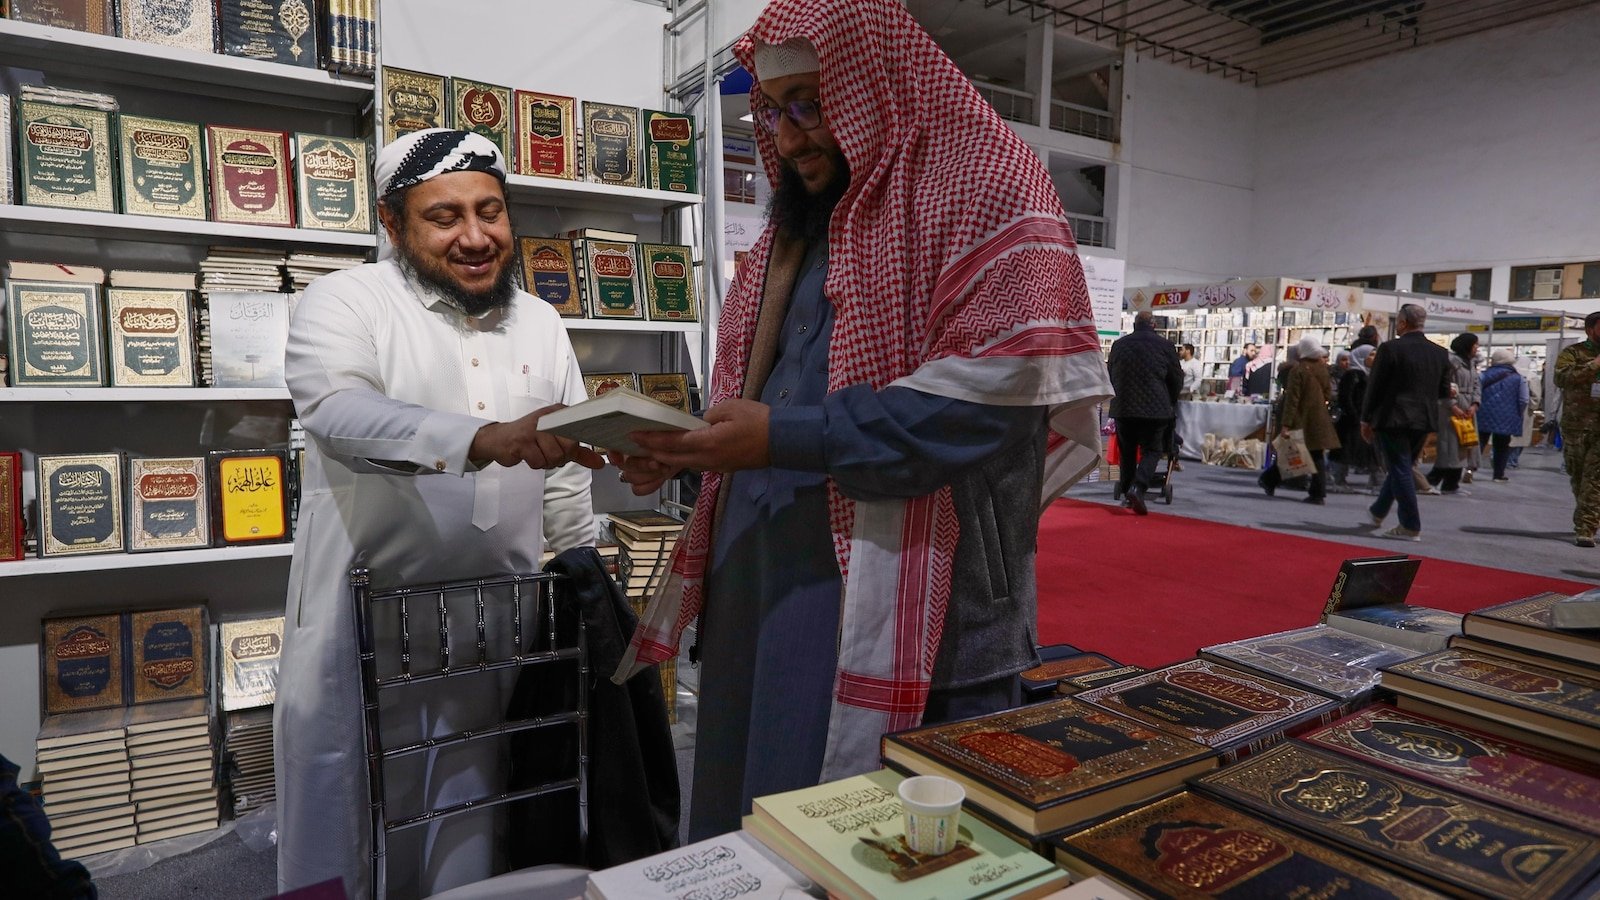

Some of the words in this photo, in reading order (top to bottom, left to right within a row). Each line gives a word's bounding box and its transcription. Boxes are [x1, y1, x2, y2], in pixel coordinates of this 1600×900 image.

[1158, 293, 1182, 305] A30
[1220, 287, 1236, 306] دار
[1289, 287, 1307, 300] A30
[228, 467, 253, 493] الهمة
